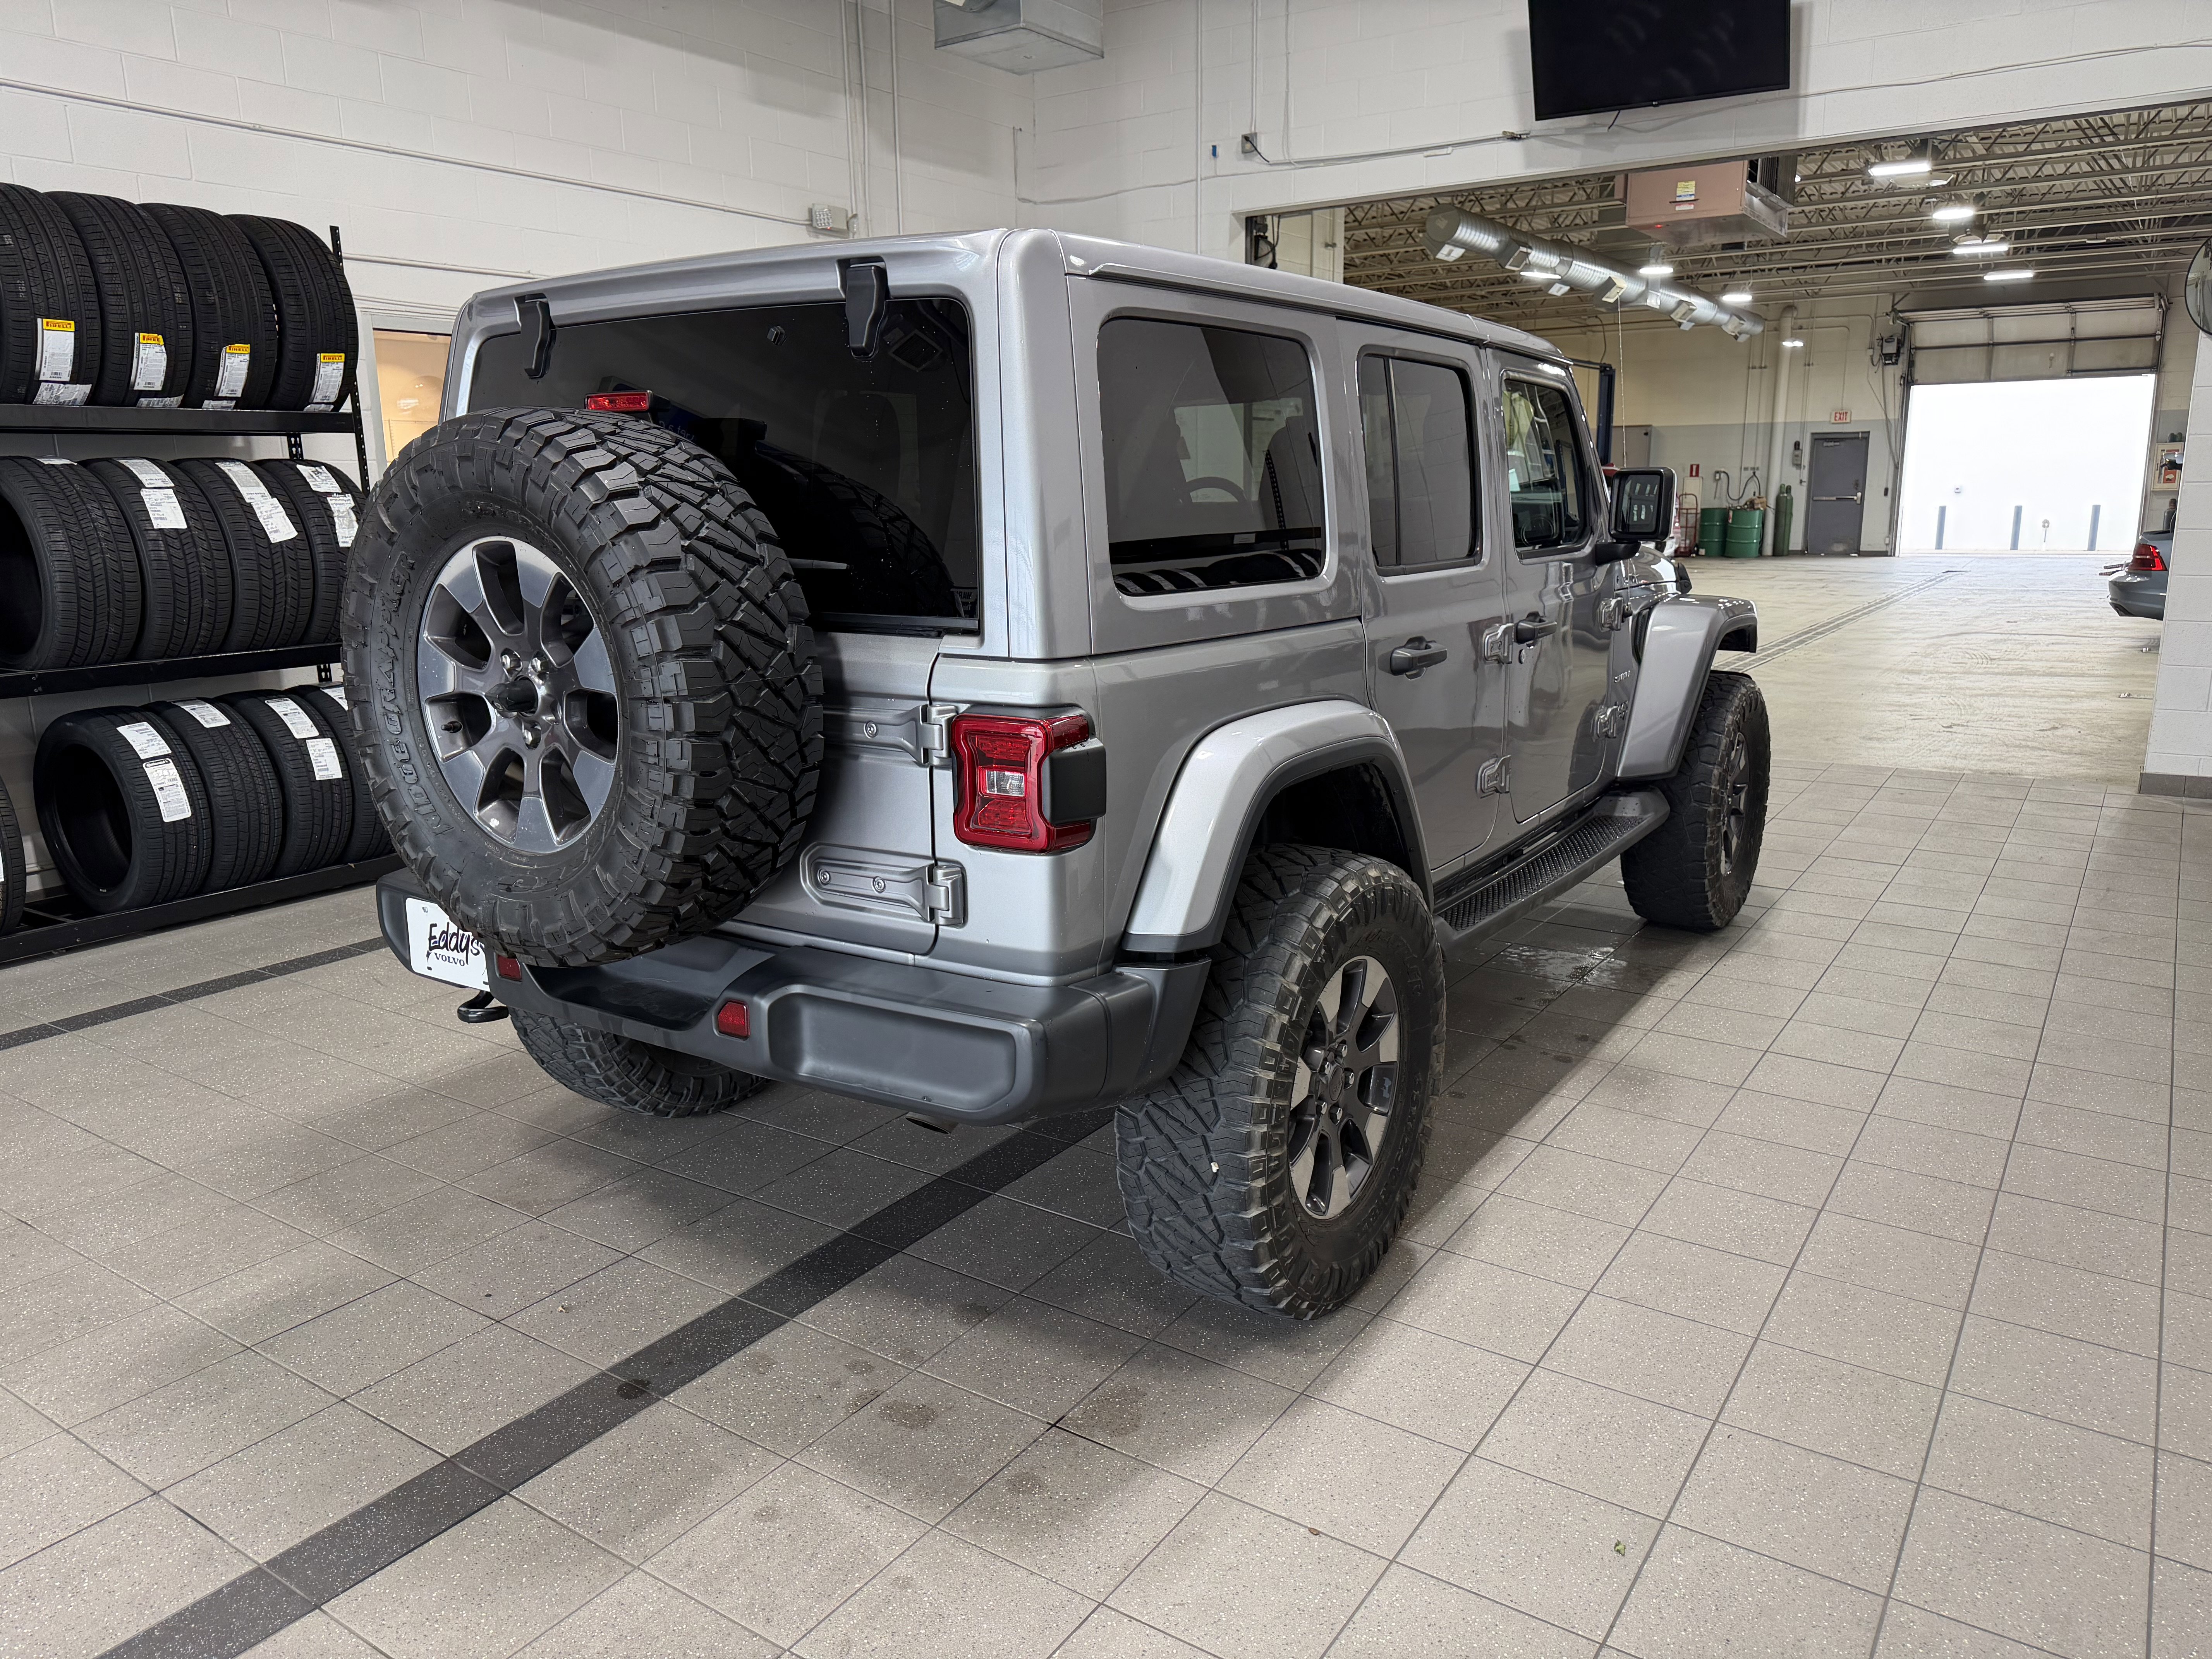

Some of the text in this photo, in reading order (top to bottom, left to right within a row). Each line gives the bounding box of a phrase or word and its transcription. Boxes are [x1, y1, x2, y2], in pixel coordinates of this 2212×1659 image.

[46, 321, 72, 329] PIRELLI
[1834, 412, 1848, 421] EXIT
[377, 551, 416, 734] GRAPPLER
[391, 740, 454, 836] RIDGE
[434, 952, 465, 967] VOLVO
